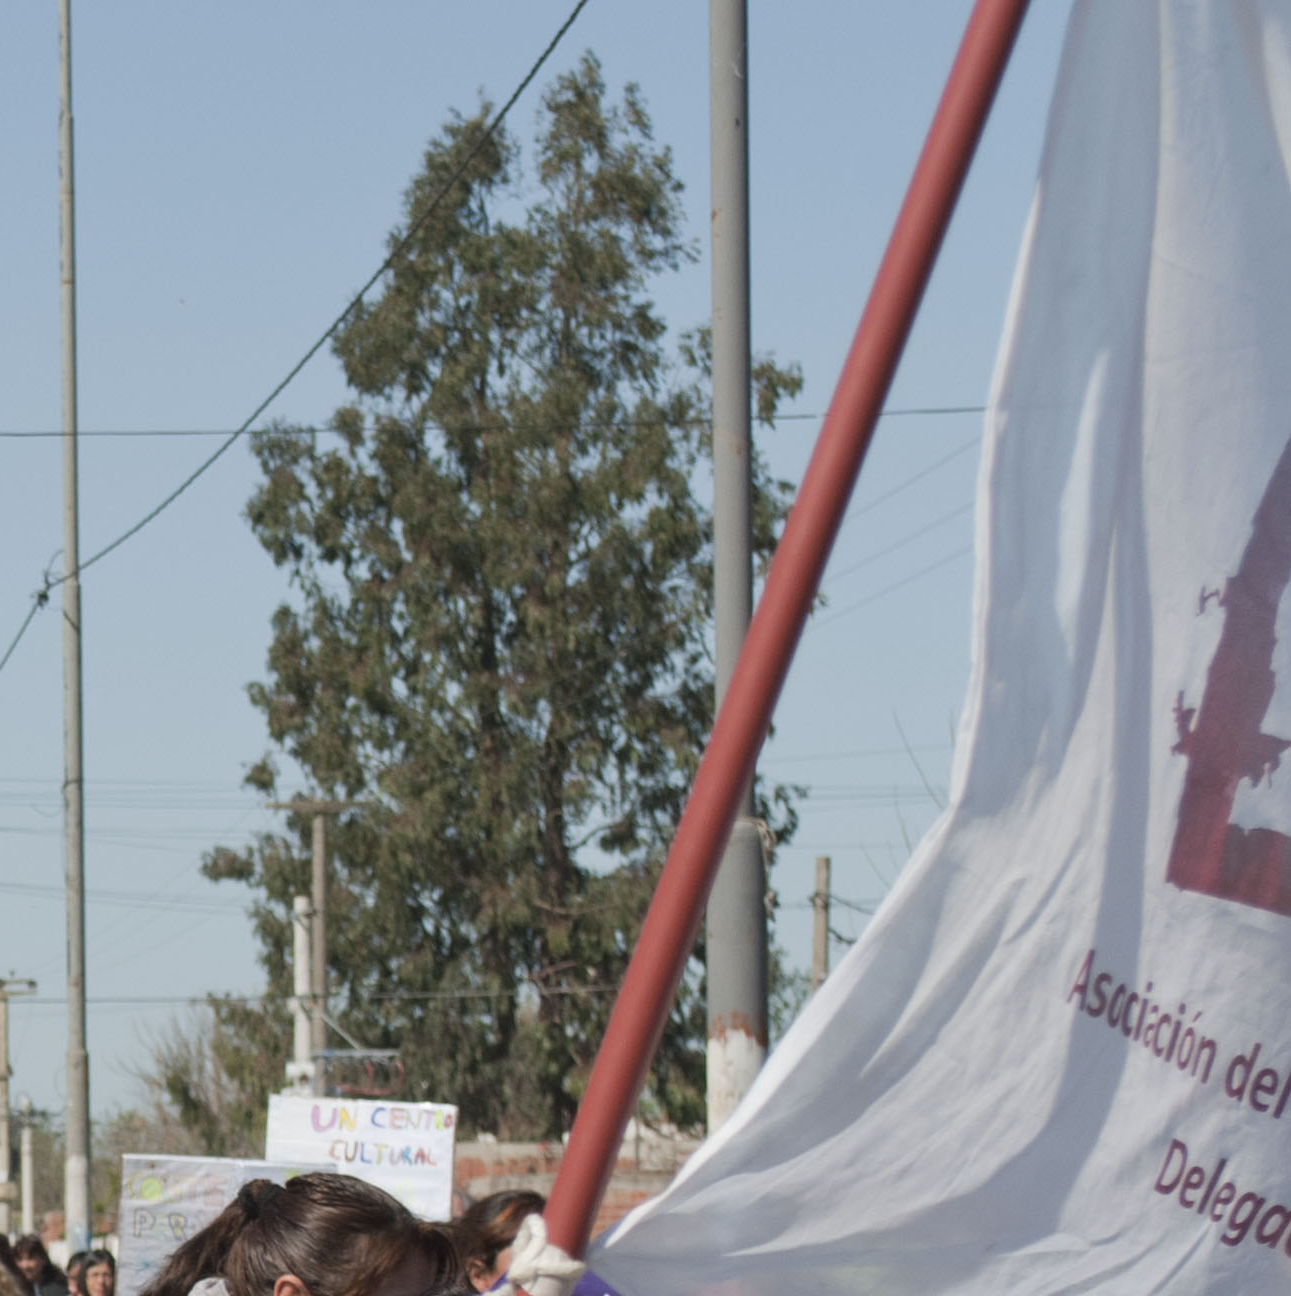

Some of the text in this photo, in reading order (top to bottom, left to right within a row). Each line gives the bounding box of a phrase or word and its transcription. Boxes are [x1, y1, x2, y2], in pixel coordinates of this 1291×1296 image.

[310, 1104, 453, 1133] UN CENTRO
[328, 1139, 438, 1167] CULTURAL
[1154, 1138, 1291, 1259] Delega
